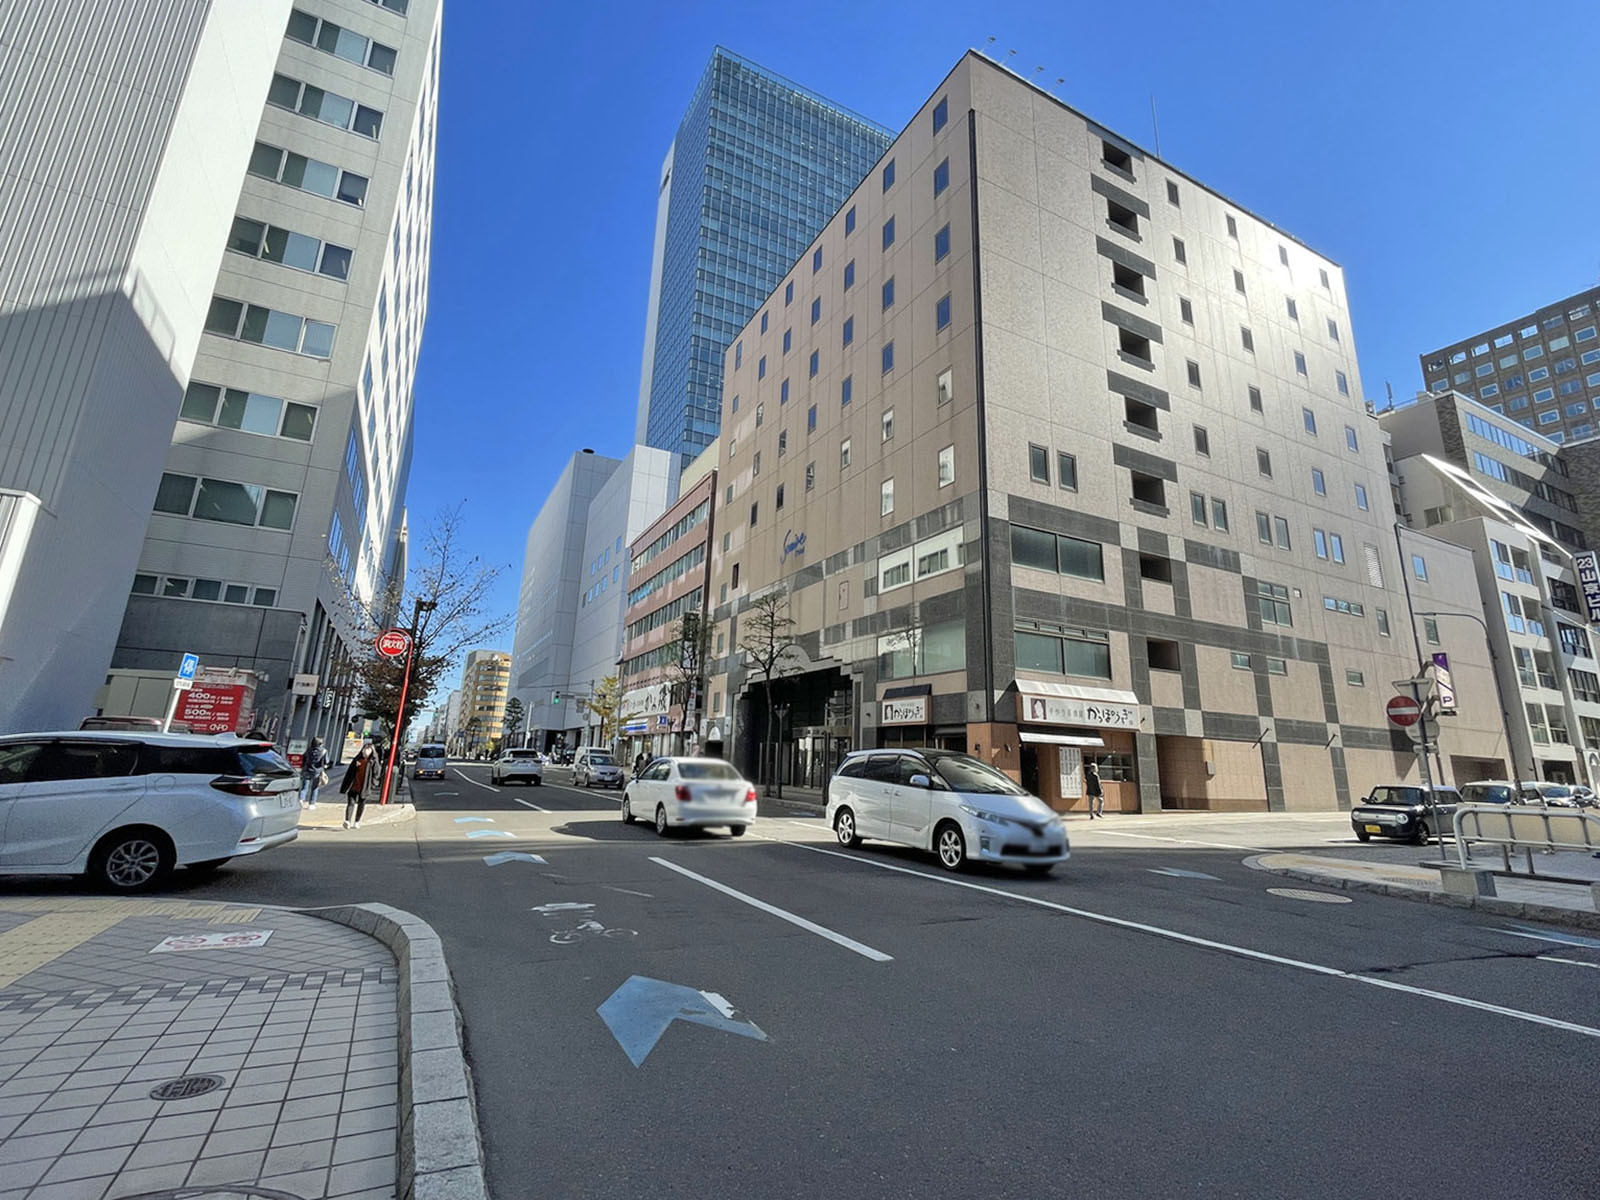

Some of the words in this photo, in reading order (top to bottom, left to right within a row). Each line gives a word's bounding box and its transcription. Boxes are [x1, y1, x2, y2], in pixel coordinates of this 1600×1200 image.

[1442, 696, 1453, 704] P
[1086, 705, 1133, 725] かっぽうぎ
